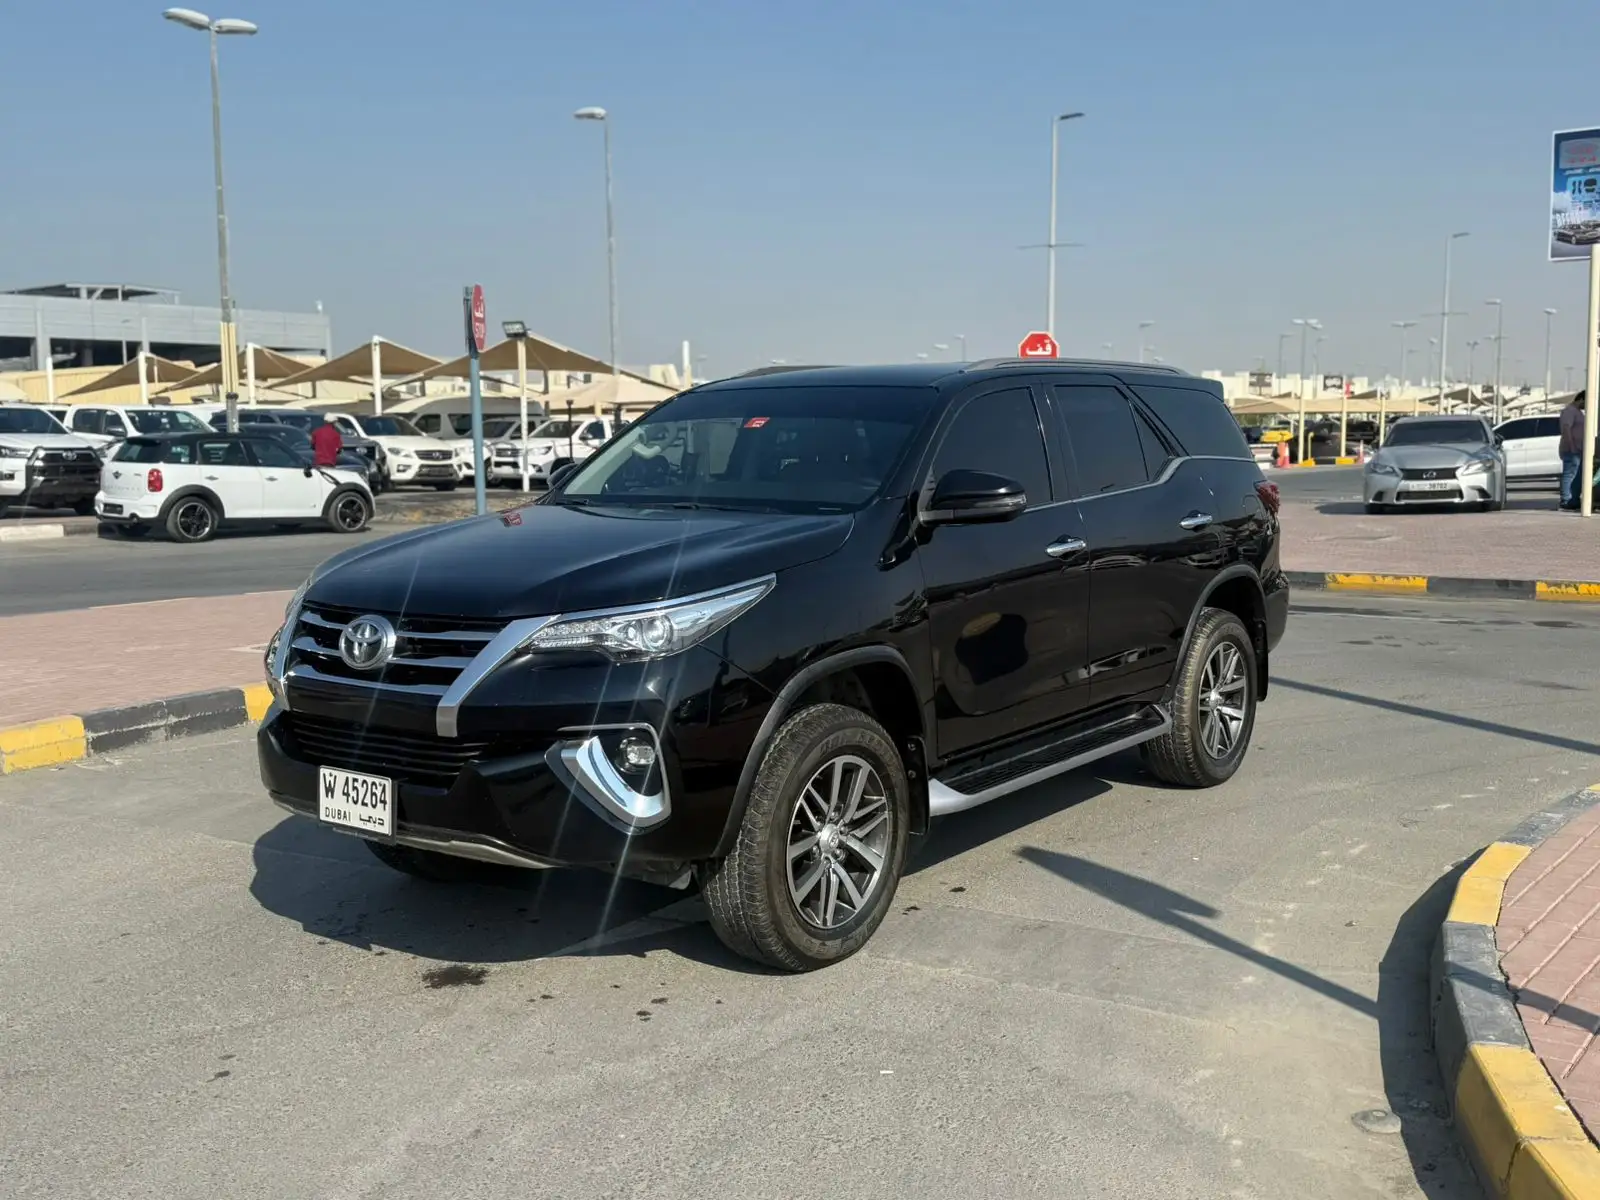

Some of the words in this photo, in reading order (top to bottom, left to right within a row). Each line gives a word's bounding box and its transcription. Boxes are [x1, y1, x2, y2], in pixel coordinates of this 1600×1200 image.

[1025, 339, 1052, 355] قف
[323, 772, 337, 799] W
[342, 776, 387, 811] 45264
[325, 807, 351, 821] DUBAI
[359, 813, 385, 828] دبي
